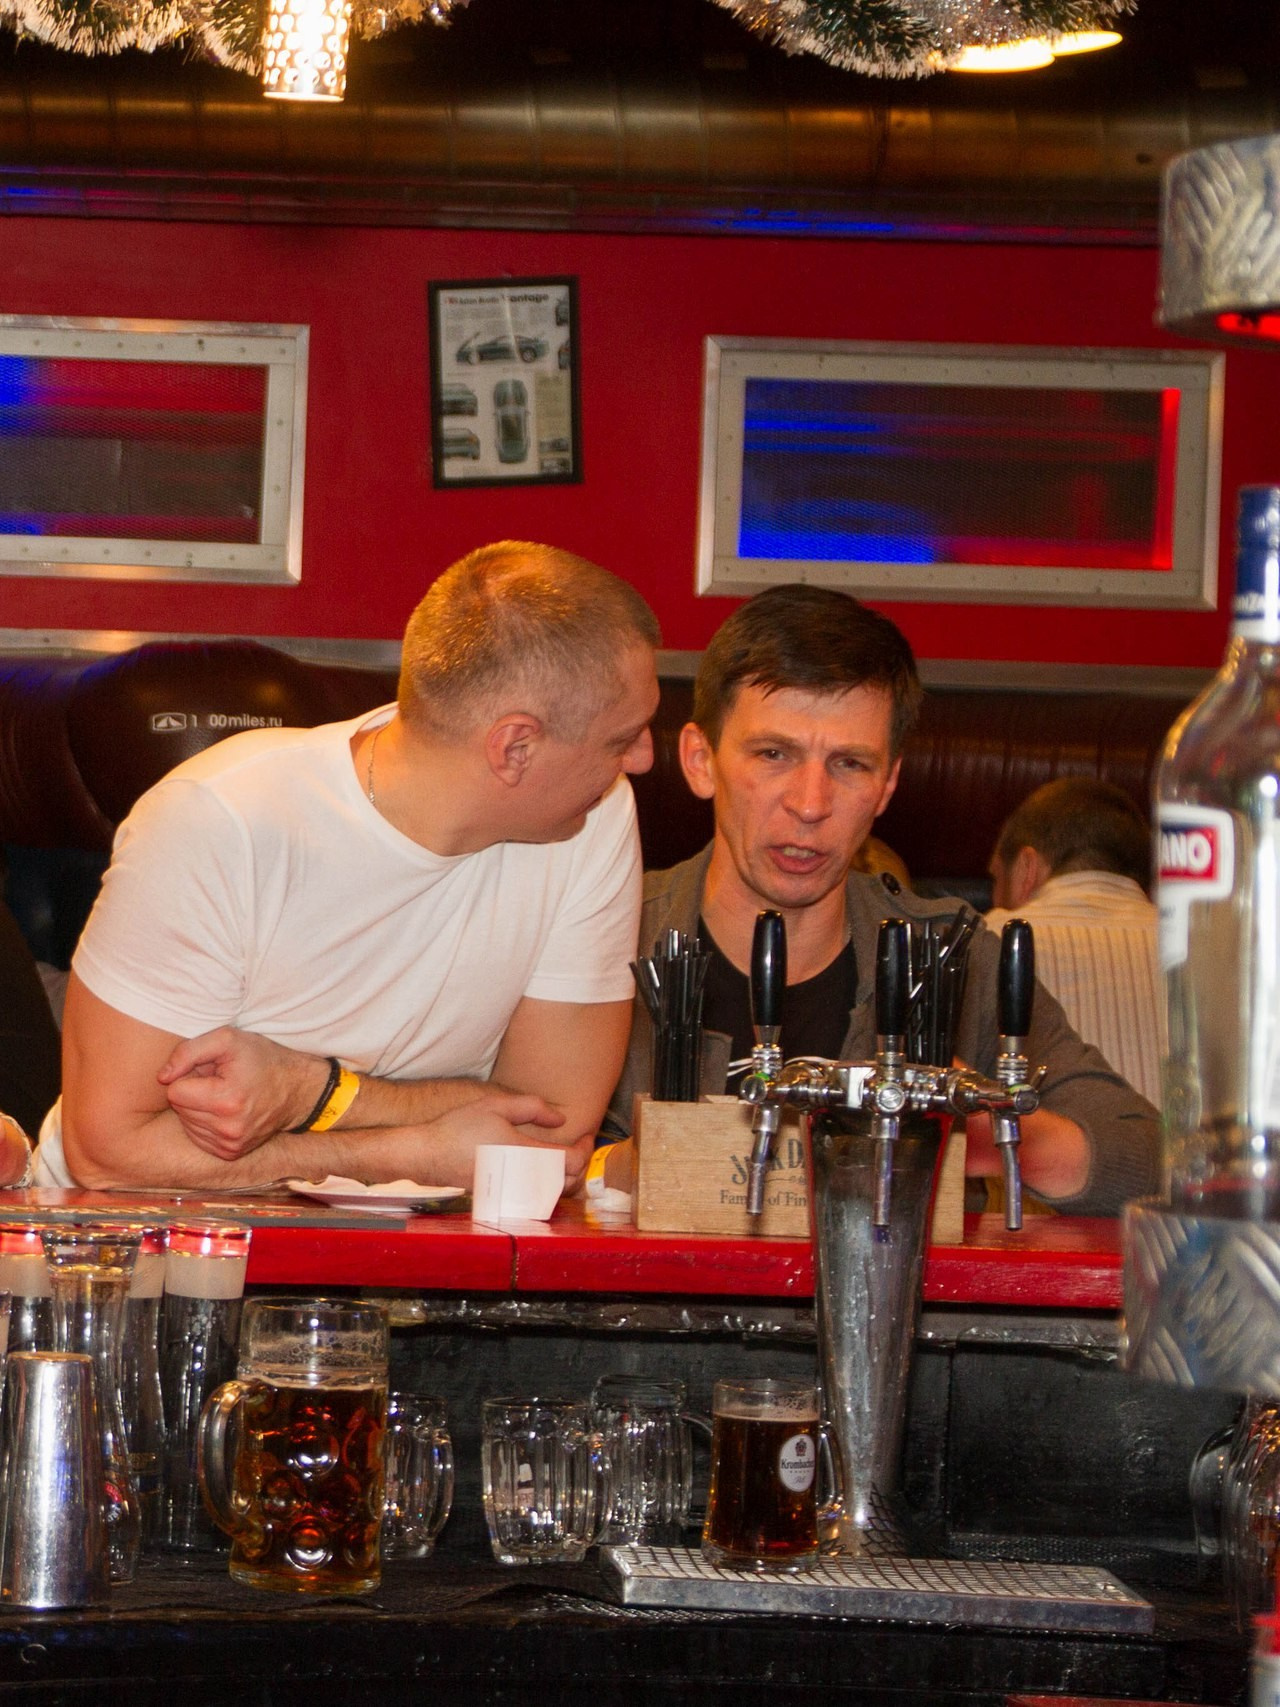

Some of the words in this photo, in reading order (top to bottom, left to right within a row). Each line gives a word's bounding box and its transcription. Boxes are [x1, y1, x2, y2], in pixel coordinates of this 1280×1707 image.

[1160, 831, 1213, 873] ANO
[768, 1191, 780, 1206] of
[783, 1191, 807, 1206] Fin
